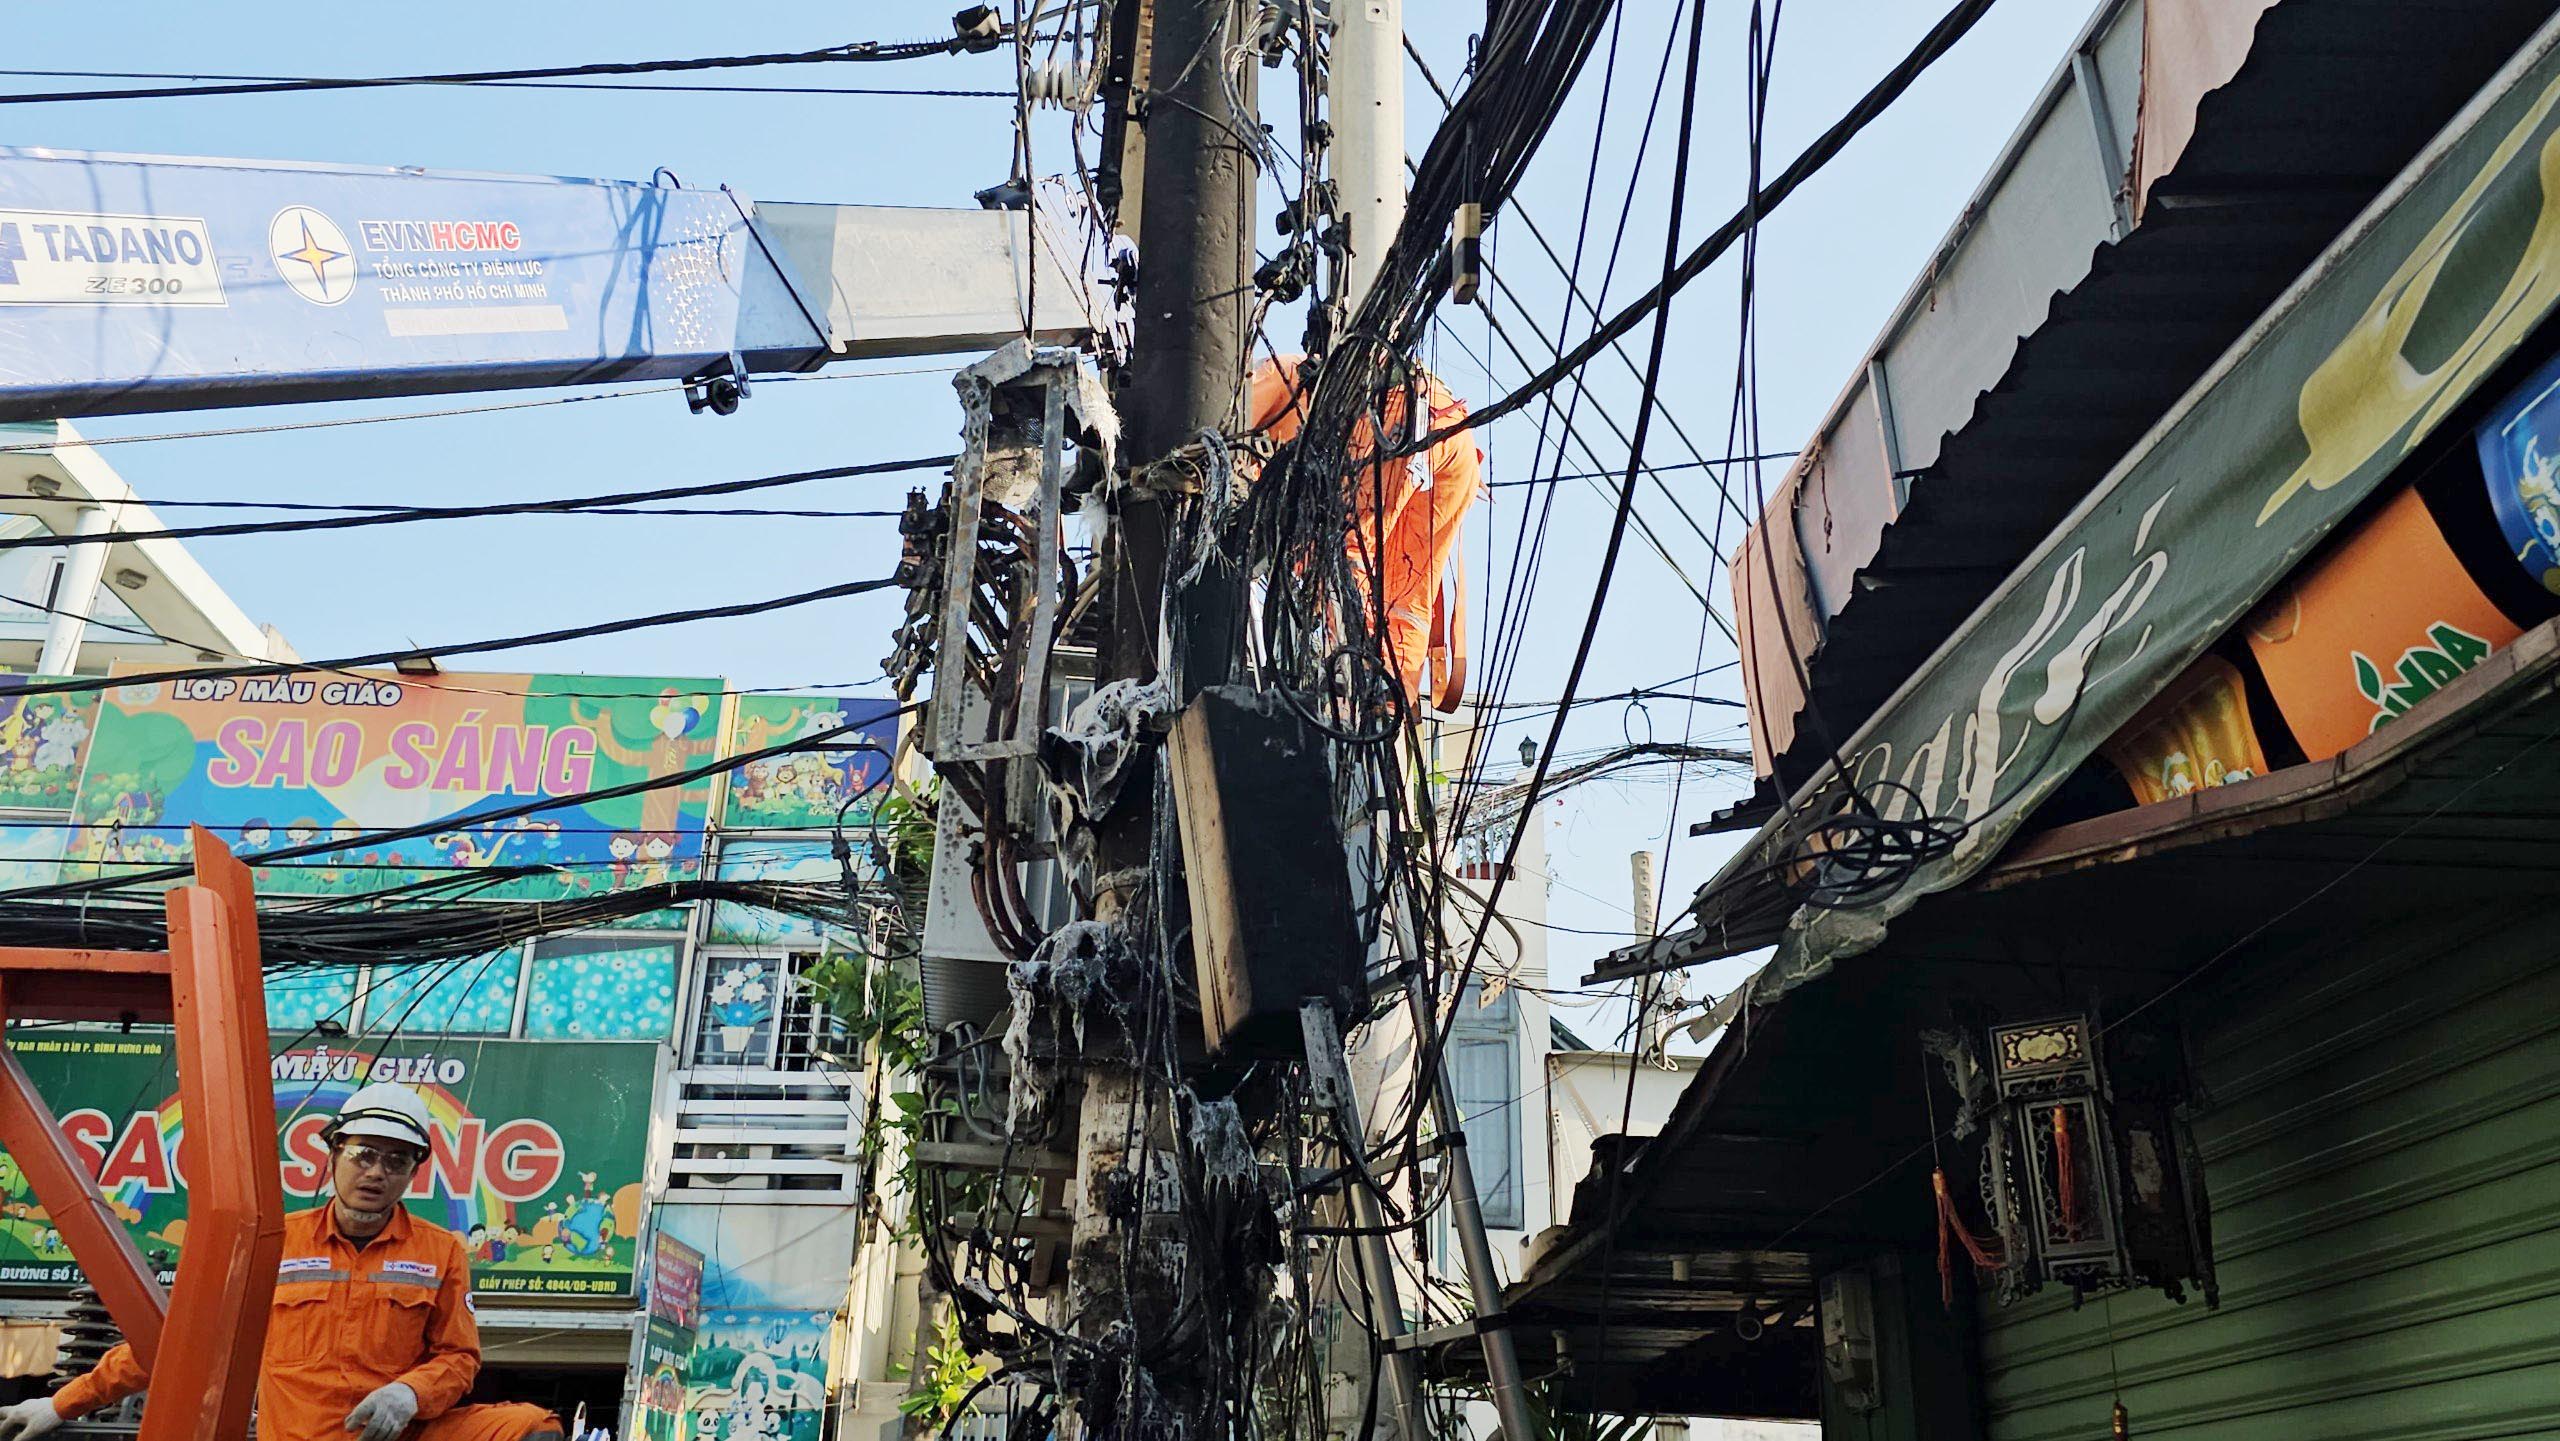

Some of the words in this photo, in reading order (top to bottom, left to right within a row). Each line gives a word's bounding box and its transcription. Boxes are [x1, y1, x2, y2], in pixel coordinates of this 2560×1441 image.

[32, 222, 203, 266] TADANO
[359, 220, 521, 251] EVNHCMC
[372, 256, 417, 279] TỔNG
[418, 258, 460, 278] CÔNG
[461, 262, 479, 277] TY
[481, 258, 515, 279] ĐIỆN
[516, 259, 544, 278] LỰC
[380, 283, 432, 303] THÀNH
[433, 280, 465, 301] PHỐ
[466, 280, 487, 299] HỒ
[489, 281, 513, 299] CHÍ
[514, 283, 548, 299] MINH
[239, 674, 316, 704] MẪU
[321, 681, 403, 708] GIÁO
[207, 716, 365, 789] SAO
[383, 709, 598, 796] SÁNG
[270, 1045, 359, 1083] MẪU
[370, 1054, 466, 1085] GIÁO
[56, 1108, 188, 1193] SA
[280, 1113, 566, 1203] SNG
